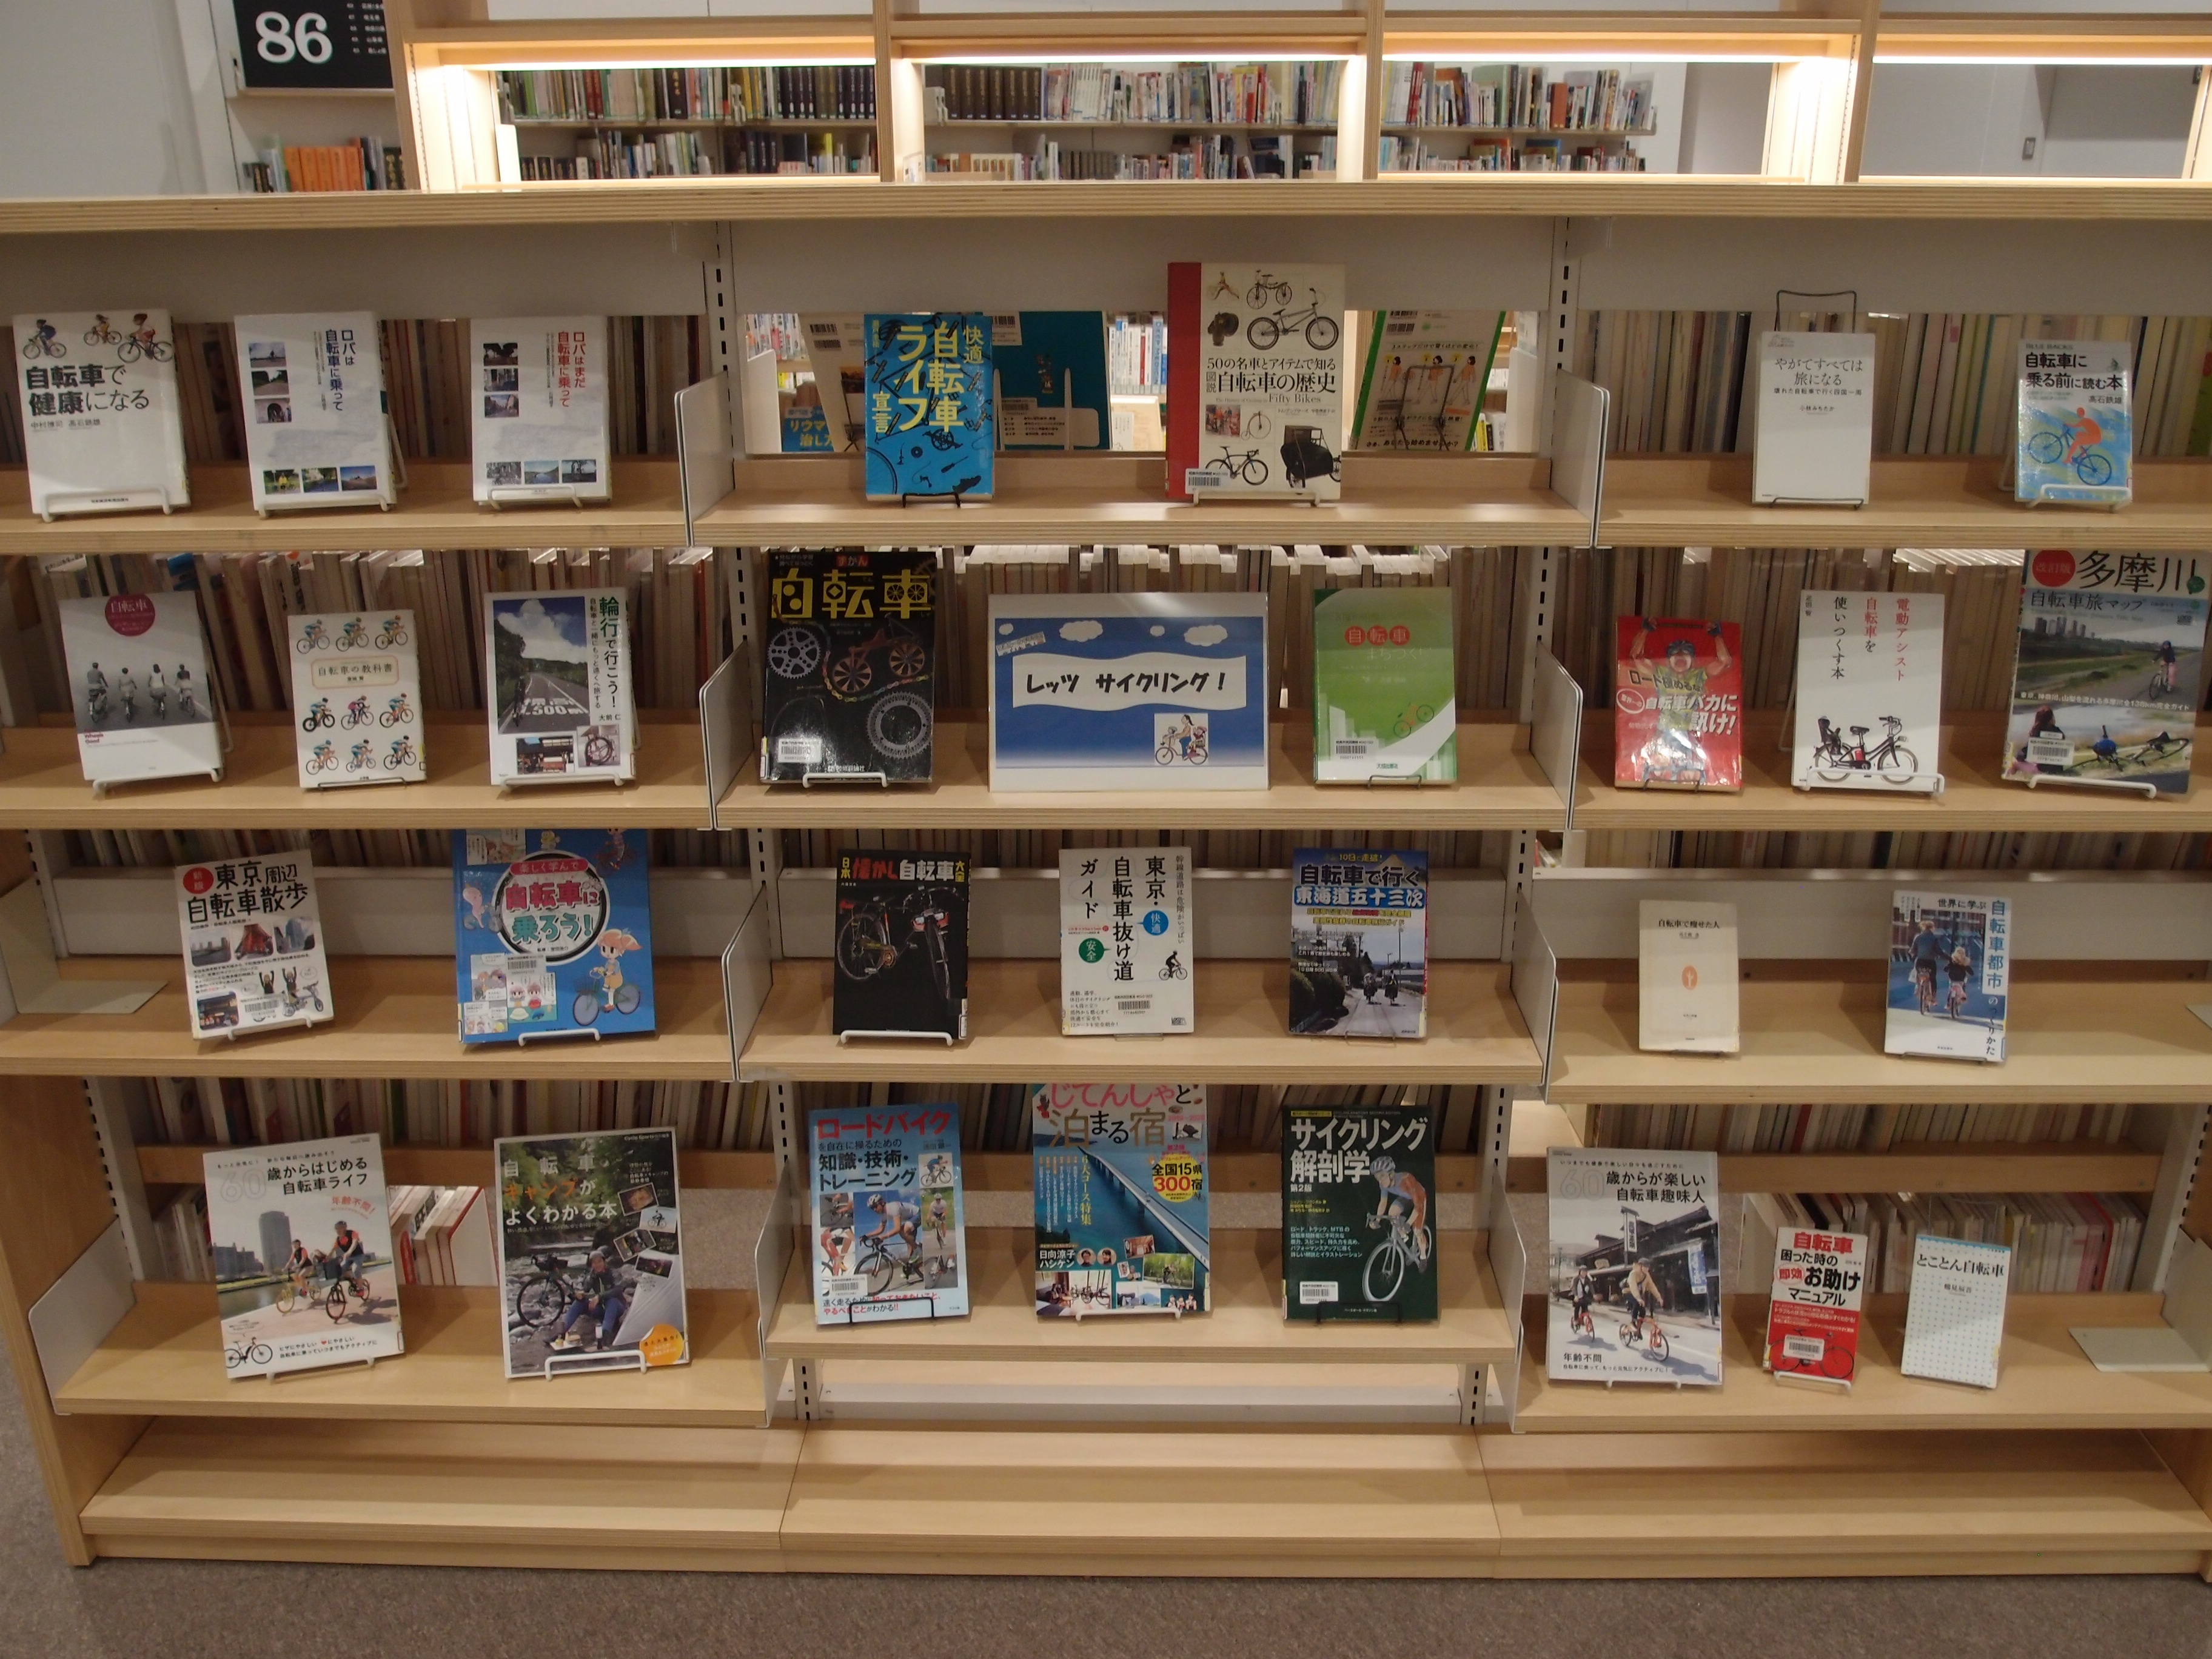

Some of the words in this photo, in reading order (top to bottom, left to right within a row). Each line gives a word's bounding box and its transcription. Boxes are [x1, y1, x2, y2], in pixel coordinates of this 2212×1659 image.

[255, 11, 333, 64] 86
[341, 329, 356, 366] ロバは
[963, 325, 985, 364] 快適
[326, 329, 343, 411] 自転車に乗って
[558, 330, 571, 407] 自転車に乗って
[573, 331, 586, 388] ロバはまだ
[1207, 357, 1336, 371] 50の名車とアイテムで知る
[1775, 358, 1863, 372] やがてすべては
[2025, 352, 2087, 369] 自転車に
[26, 363, 126, 389] 自転車で
[894, 326, 928, 431] ライフ
[927, 321, 965, 433] 自転車
[1206, 372, 1216, 393] 図説
[1218, 371, 1336, 394] 自転車の歴史
[1794, 372, 1842, 386] 旅になる
[2026, 372, 2123, 390] 乗る前に読む本
[29, 389, 150, 416] 健康になる
[1269, 394, 1290, 406] Fifty
[1295, 393, 1321, 403] Bikes
[2077, 550, 2196, 593] 多摩川
[771, 568, 931, 619] 自転車
[2031, 591, 2143, 611] 自転車旅マップ
[1349, 628, 1407, 643] 自転車
[1863, 597, 1879, 652] 自転車を
[1831, 596, 1848, 680] 使いつくす本
[1895, 597, 1909, 682] 電動アシスト
[598, 596, 620, 708] 輪行で行こう!
[318, 663, 392, 677] 自転車の教科書
[1026, 673, 1080, 694] レッツ
[1095, 672, 1226, 694] サイクリング！
[1645, 694, 1738, 712] 自転車バカに
[1689, 711, 1736, 736] 訊け!
[215, 860, 298, 890] 東京周辺
[841, 857, 851, 879] 日本
[853, 857, 900, 879] 懐かし
[900, 859, 954, 881] 自転車
[1300, 864, 1419, 887] 自転車で行く
[1081, 859, 1099, 919] ガイド
[1145, 856, 1166, 906] 東京・
[187, 883, 308, 924] 自転車散歩
[505, 880, 601, 911] 自転車に
[1176, 854, 1185, 944] 幹線道路は危険がいっぱい
[1296, 886, 1423, 907] 東海道五十三次
[1937, 898, 1986, 910] 世界に学ぶ
[512, 913, 594, 943] 乗ろう!
[1113, 856, 1134, 981] 自転車抜け道
[1151, 912, 1162, 934] 快適
[1658, 919, 1720, 930] 自転車で痩せた人
[1085, 940, 1097, 962] 安全
[1985, 900, 2005, 1056] 自転車都市のつくりかた
[1051, 1084, 1193, 1108] じてんしゃと
[817, 1110, 951, 1140] ロードバイク
[1048, 1107, 1166, 1149] 泊まる宿
[1291, 1117, 1428, 1151] サイクリング
[818, 1139, 902, 1151] を自在に操るための
[504, 1153, 595, 1178] 自転車
[819, 1151, 910, 1172] 知識・技術・
[1152, 1162, 1203, 1176] 全国15県
[1290, 1150, 1370, 1184] 解剖学
[220, 1168, 267, 1204] 60
[267, 1157, 367, 1181] 歳からはじめる
[283, 1173, 368, 1196] 自転車ライフ
[503, 1177, 597, 1201] キャンプが
[820, 1167, 917, 1192] トレーニング
[1080, 1155, 1092, 1226] 6大コース特集
[1153, 1176, 1203, 1193] 300宿
[1290, 1183, 1312, 1193] 第2版
[1560, 1169, 1604, 1202] 60
[1606, 1171, 1706, 1185] 歳からが楽しい
[1617, 1187, 1706, 1204] 自転車趣味人
[506, 1201, 617, 1226] よくわかる本
[1039, 1249, 1076, 1259] 日向涼子
[1793, 1232, 1854, 1254] 自転車
[1039, 1259, 1075, 1269] ハシケン
[1780, 1248, 1838, 1267] 困った時の
[1917, 1253, 2004, 1278] とことん自転車
[1804, 1265, 1861, 1291] お助け
[1788, 1287, 1846, 1307] マニュアル
[1563, 1352, 1602, 1363] 年齢不問
